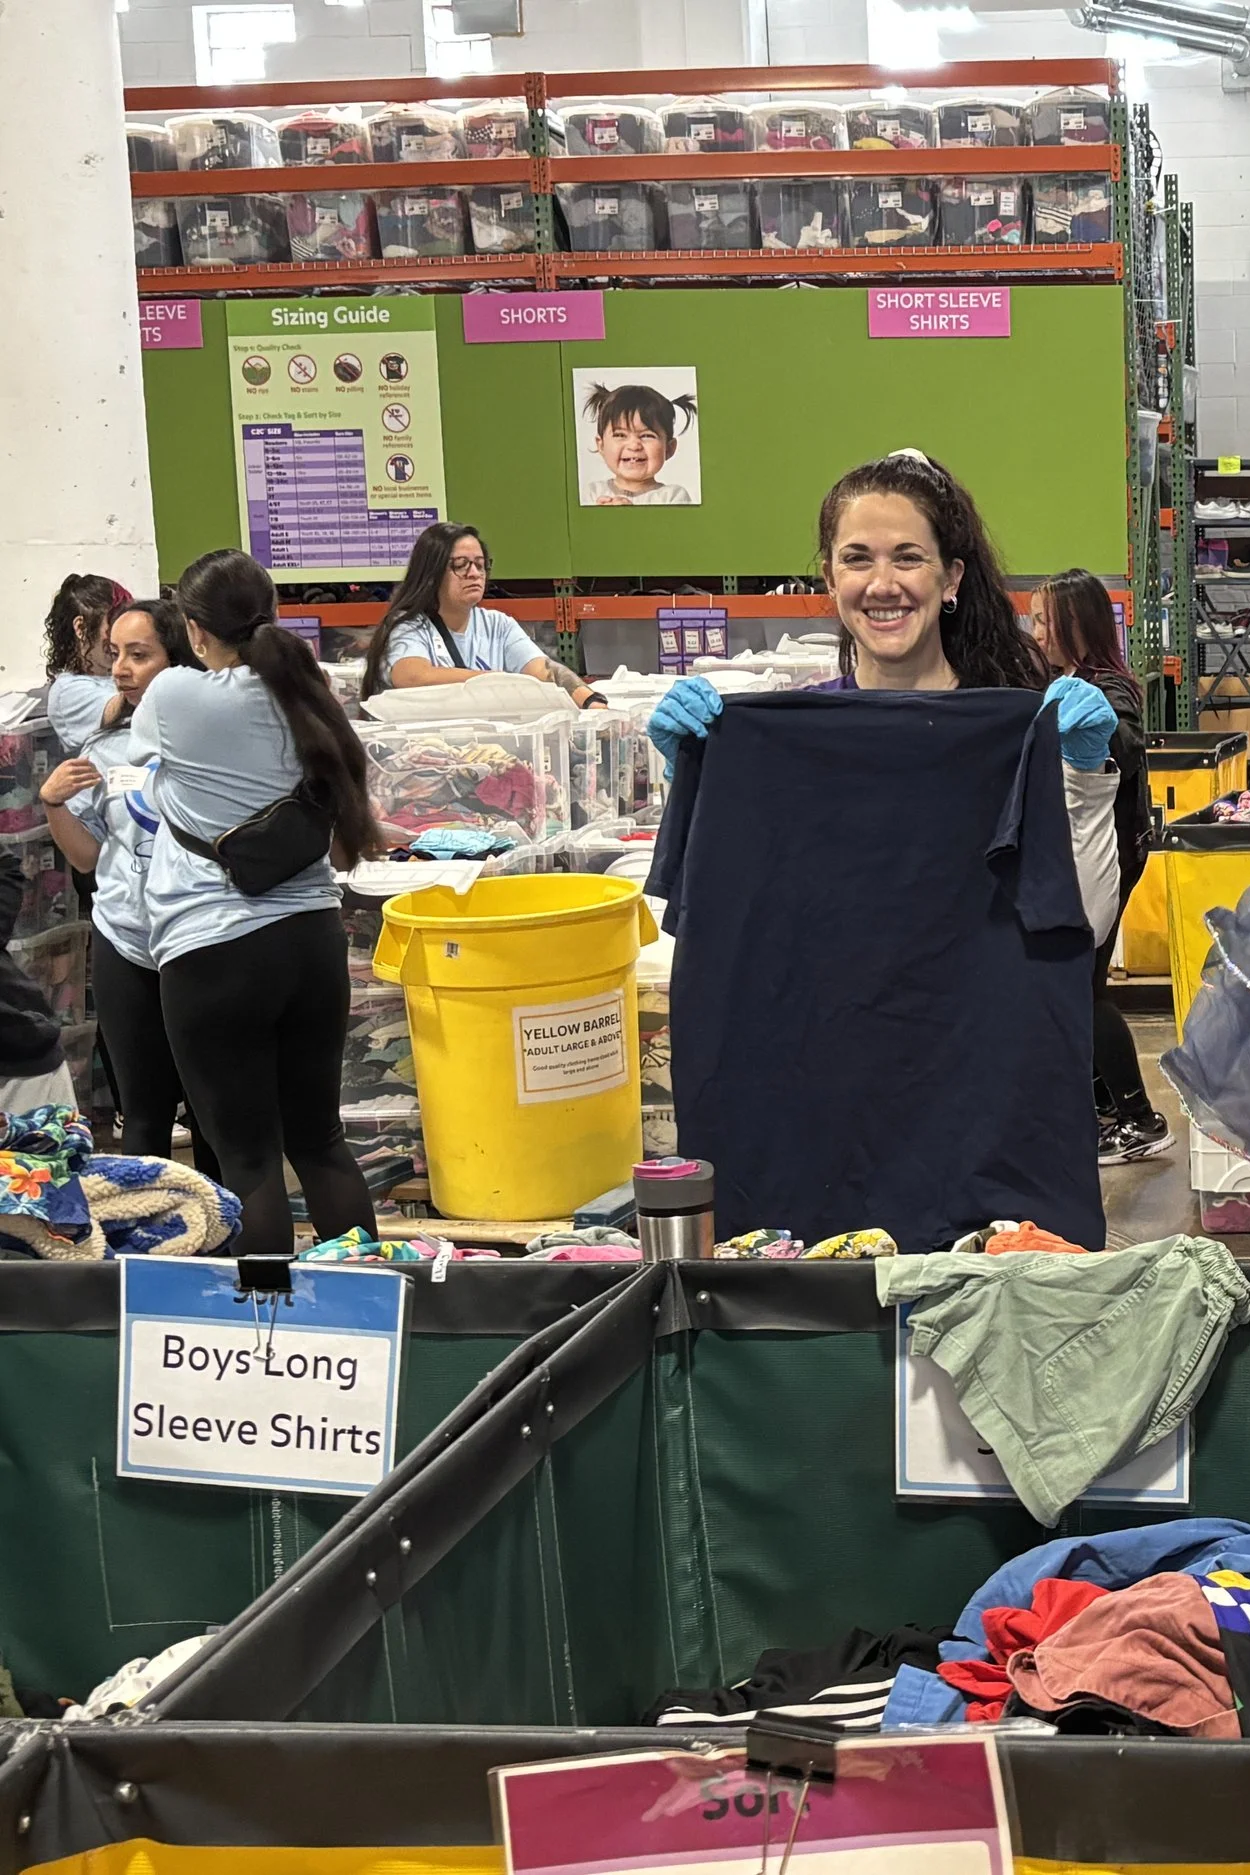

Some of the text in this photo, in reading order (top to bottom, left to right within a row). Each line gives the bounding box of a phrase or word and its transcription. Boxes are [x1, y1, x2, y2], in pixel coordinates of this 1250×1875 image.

[877, 292, 1002, 308] SHORT SLEEVE
[271, 305, 390, 328] Sizing Guide
[500, 307, 567, 324] SHORTS
[910, 314, 970, 330] SHIRTS
[257, 343, 280, 352] Quality
[267, 427, 281, 435] SIZE
[524, 1013, 620, 1041] YELLOW BARREL
[561, 1039, 589, 1052] LARGE
[590, 1039, 597, 1047] &
[162, 1334, 358, 1390] Boys Long
[133, 1402, 381, 1456] Sleeve Shirts
